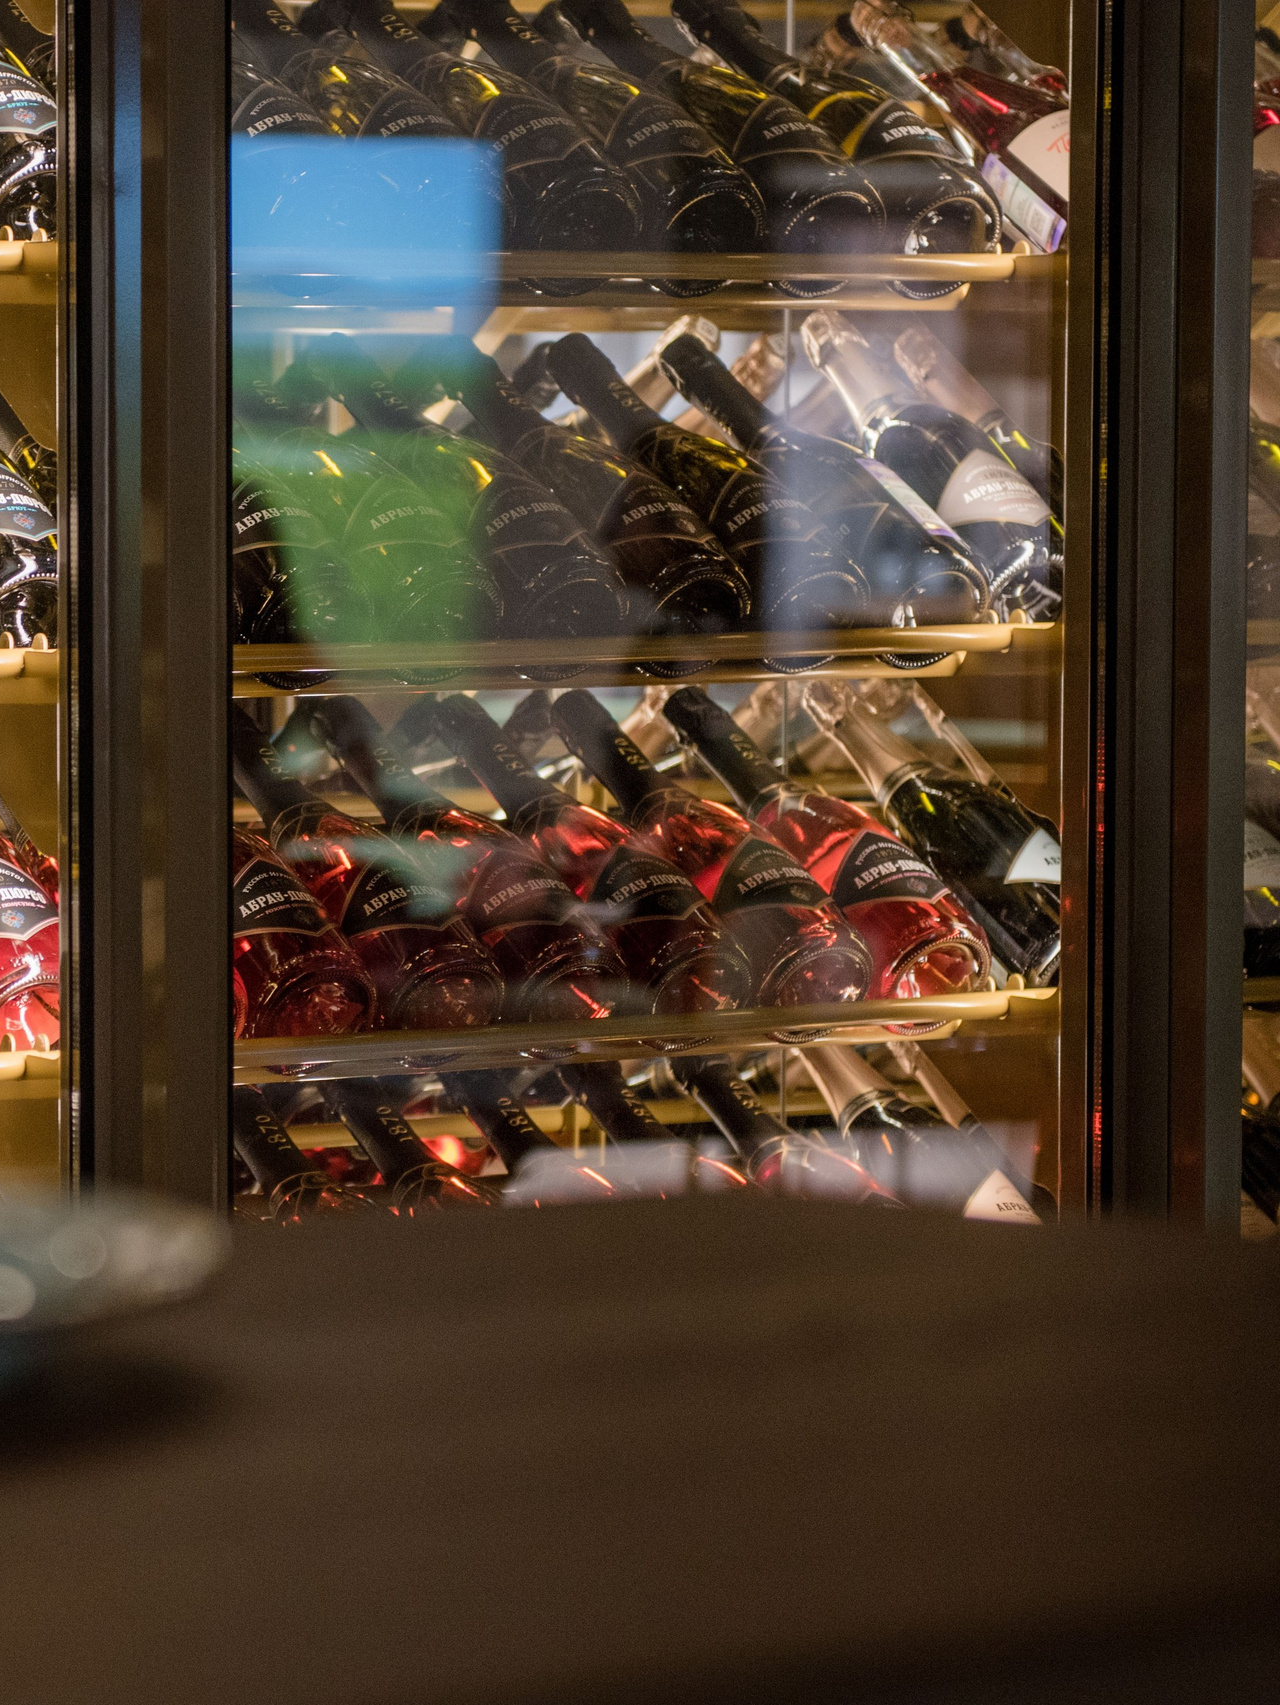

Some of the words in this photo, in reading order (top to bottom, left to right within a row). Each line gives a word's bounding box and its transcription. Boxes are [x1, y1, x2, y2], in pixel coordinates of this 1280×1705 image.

[255, 1115, 291, 1151] 1870
[376, 1105, 412, 1142] 1870
[497, 1097, 534, 1133] 1870
